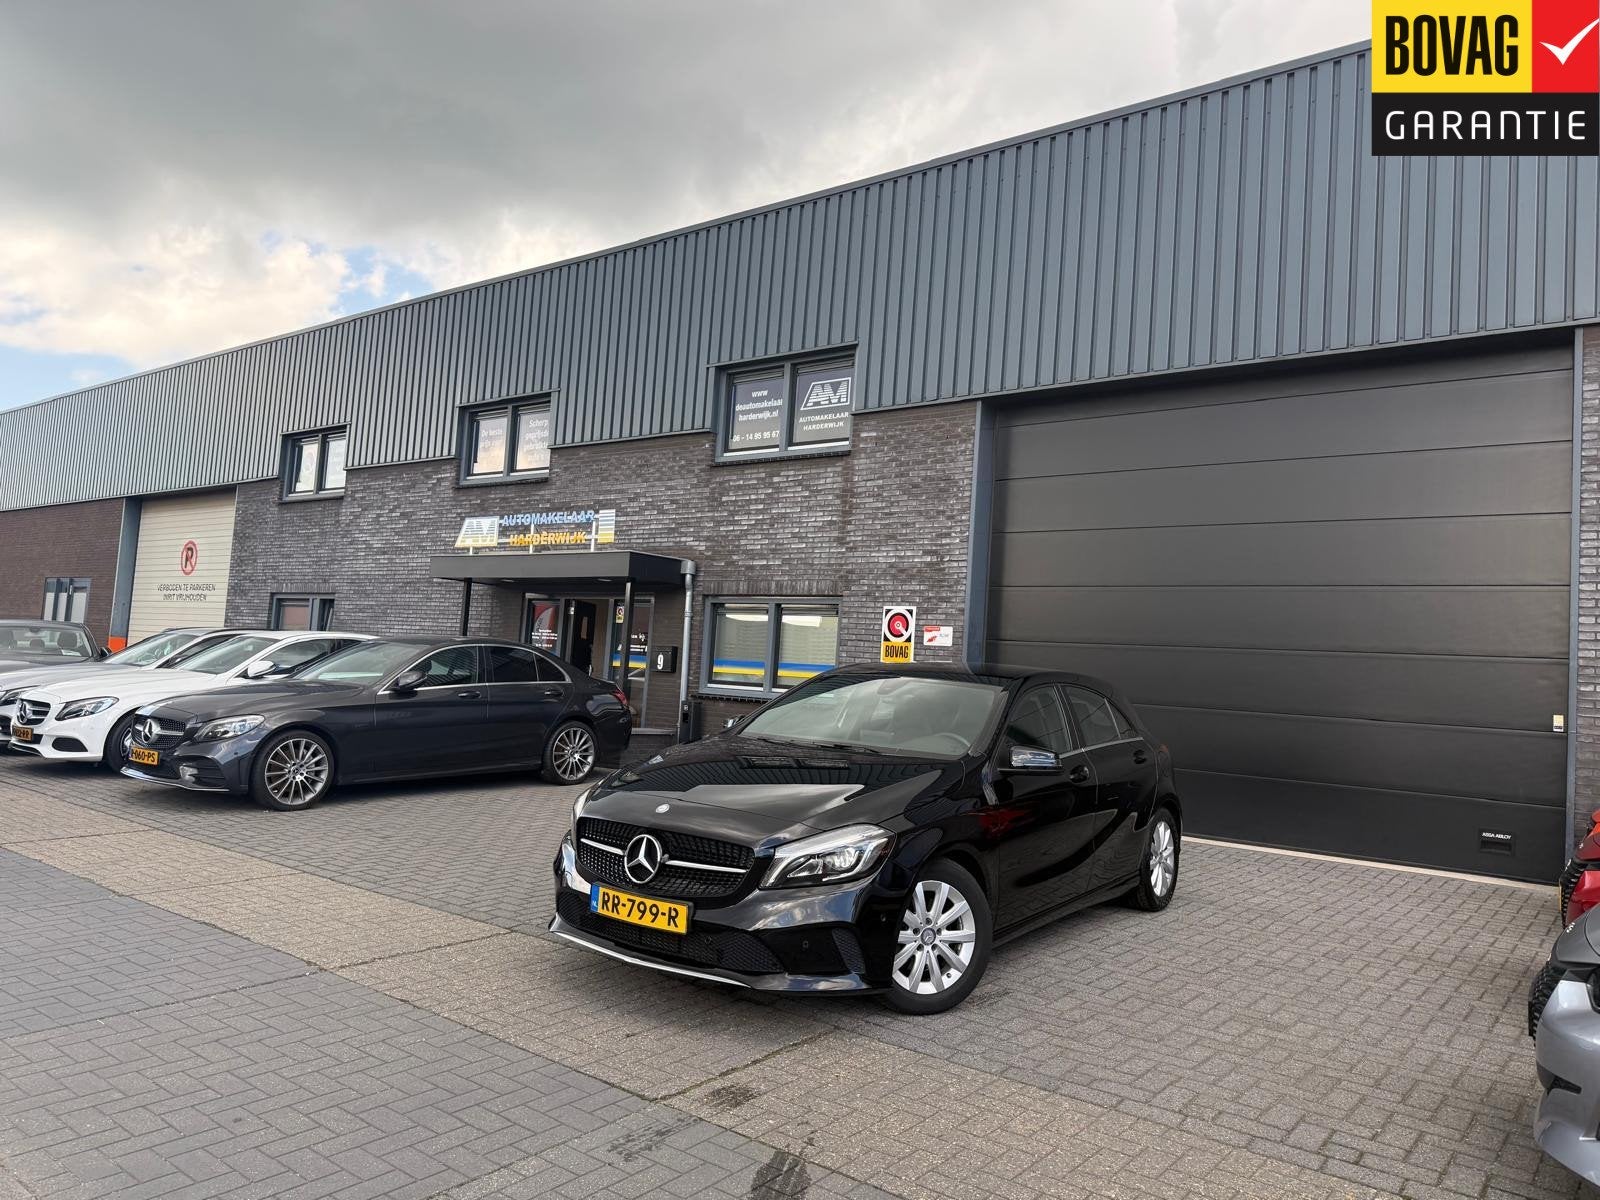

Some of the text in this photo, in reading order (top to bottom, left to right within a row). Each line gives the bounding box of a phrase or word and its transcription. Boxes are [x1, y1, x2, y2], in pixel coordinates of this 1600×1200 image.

[751, 390, 769, 398] www
[738, 410, 779, 422] harderwijk.nl
[799, 412, 849, 423] AUTOMAKELAAR
[803, 421, 845, 431] HARDERWIJK
[746, 433, 753, 441] 14
[502, 510, 595, 527] AUTOMAKELAAR
[509, 530, 586, 546] HARDERWIJK
[157, 584, 182, 592] VERBODEN
[189, 583, 216, 592] PARKEREN
[885, 645, 909, 659] BOVAG
[656, 654, 664, 670] 9
[601, 891, 680, 928] RR-799-R
